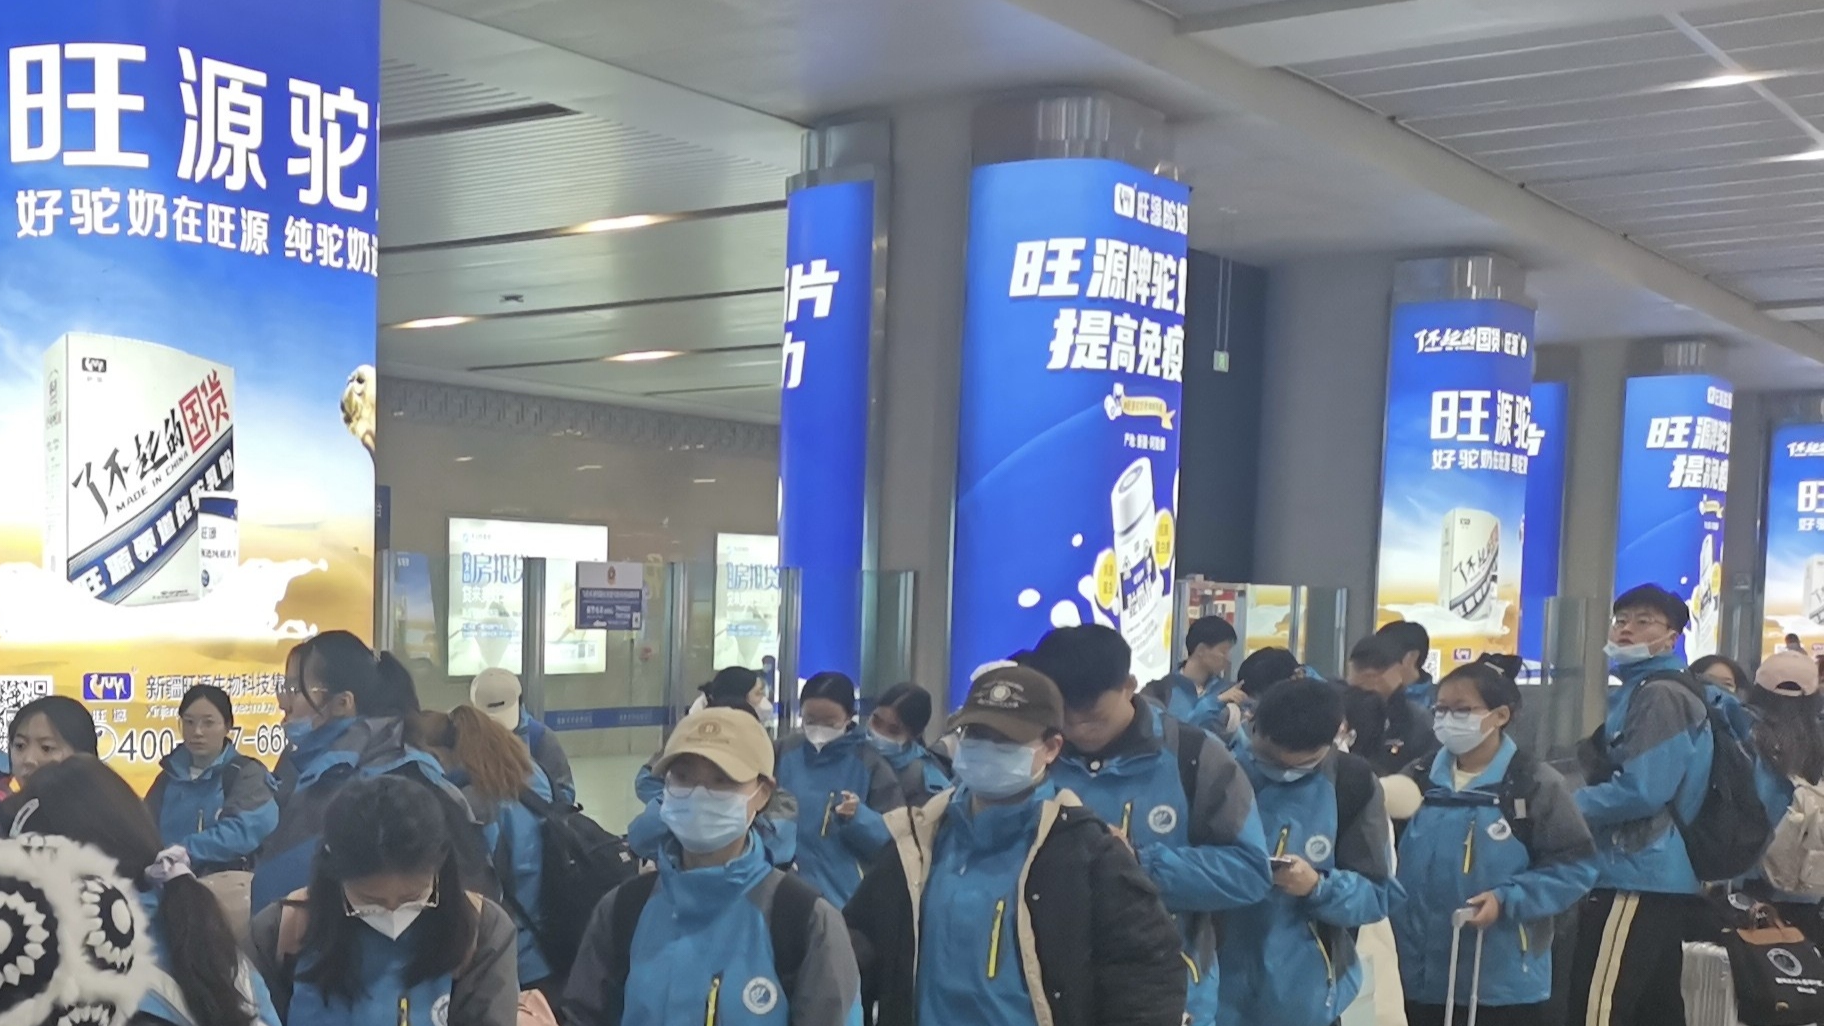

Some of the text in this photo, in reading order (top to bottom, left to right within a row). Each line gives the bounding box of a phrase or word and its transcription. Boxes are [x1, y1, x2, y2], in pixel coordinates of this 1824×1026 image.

[8, 43, 380, 212] 旺源驼
[16, 187, 269, 256] 好驼奶在旺源
[1046, 308, 1183, 382] 提高免疫
[72, 368, 230, 525] 了不起的国货
[1430, 390, 1533, 449] 旺源驼
[116, 450, 189, 513] MADE IN CHINA
